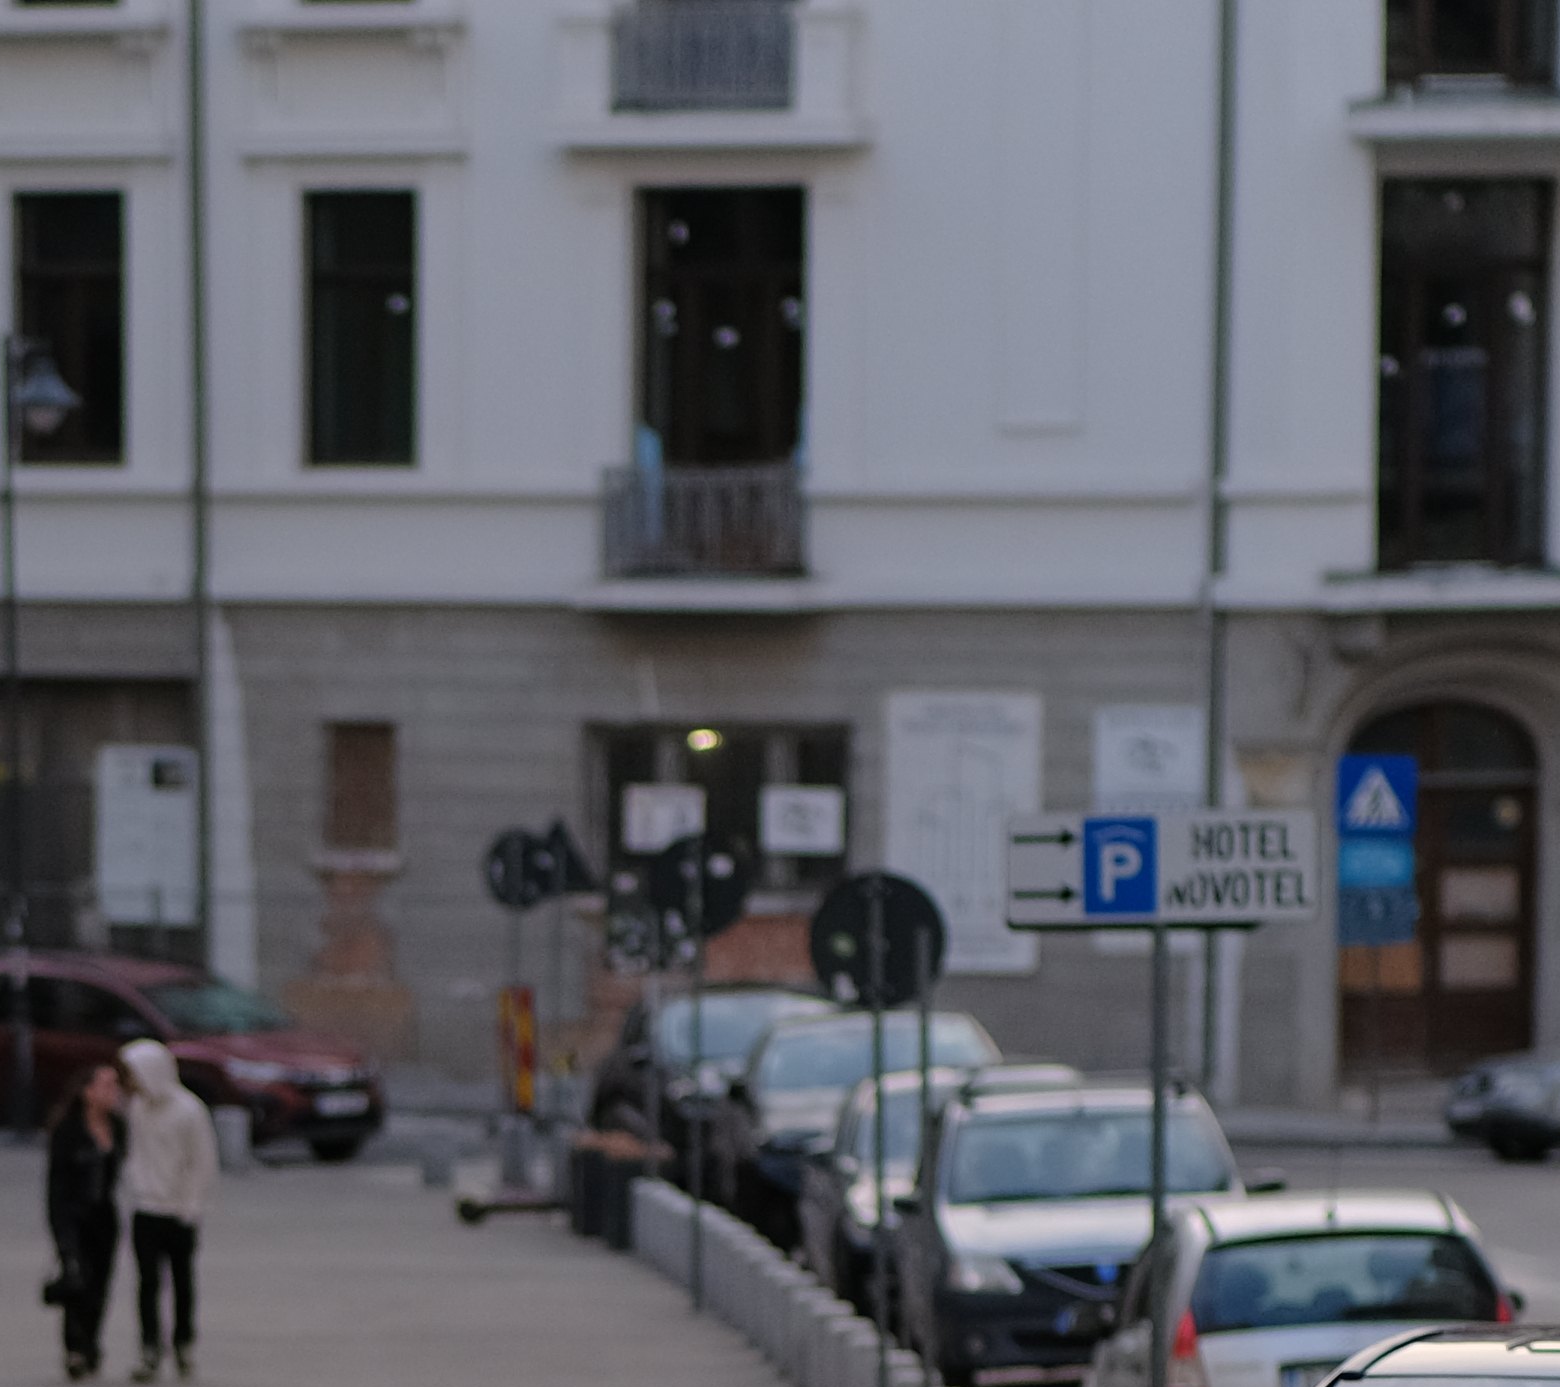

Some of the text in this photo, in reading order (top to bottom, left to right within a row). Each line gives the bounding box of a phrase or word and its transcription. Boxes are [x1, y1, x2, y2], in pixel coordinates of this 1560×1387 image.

[1190, 822, 1294, 861] HOTEL
[1098, 842, 1143, 903] P
[1168, 871, 1307, 908] NOVOTEL
